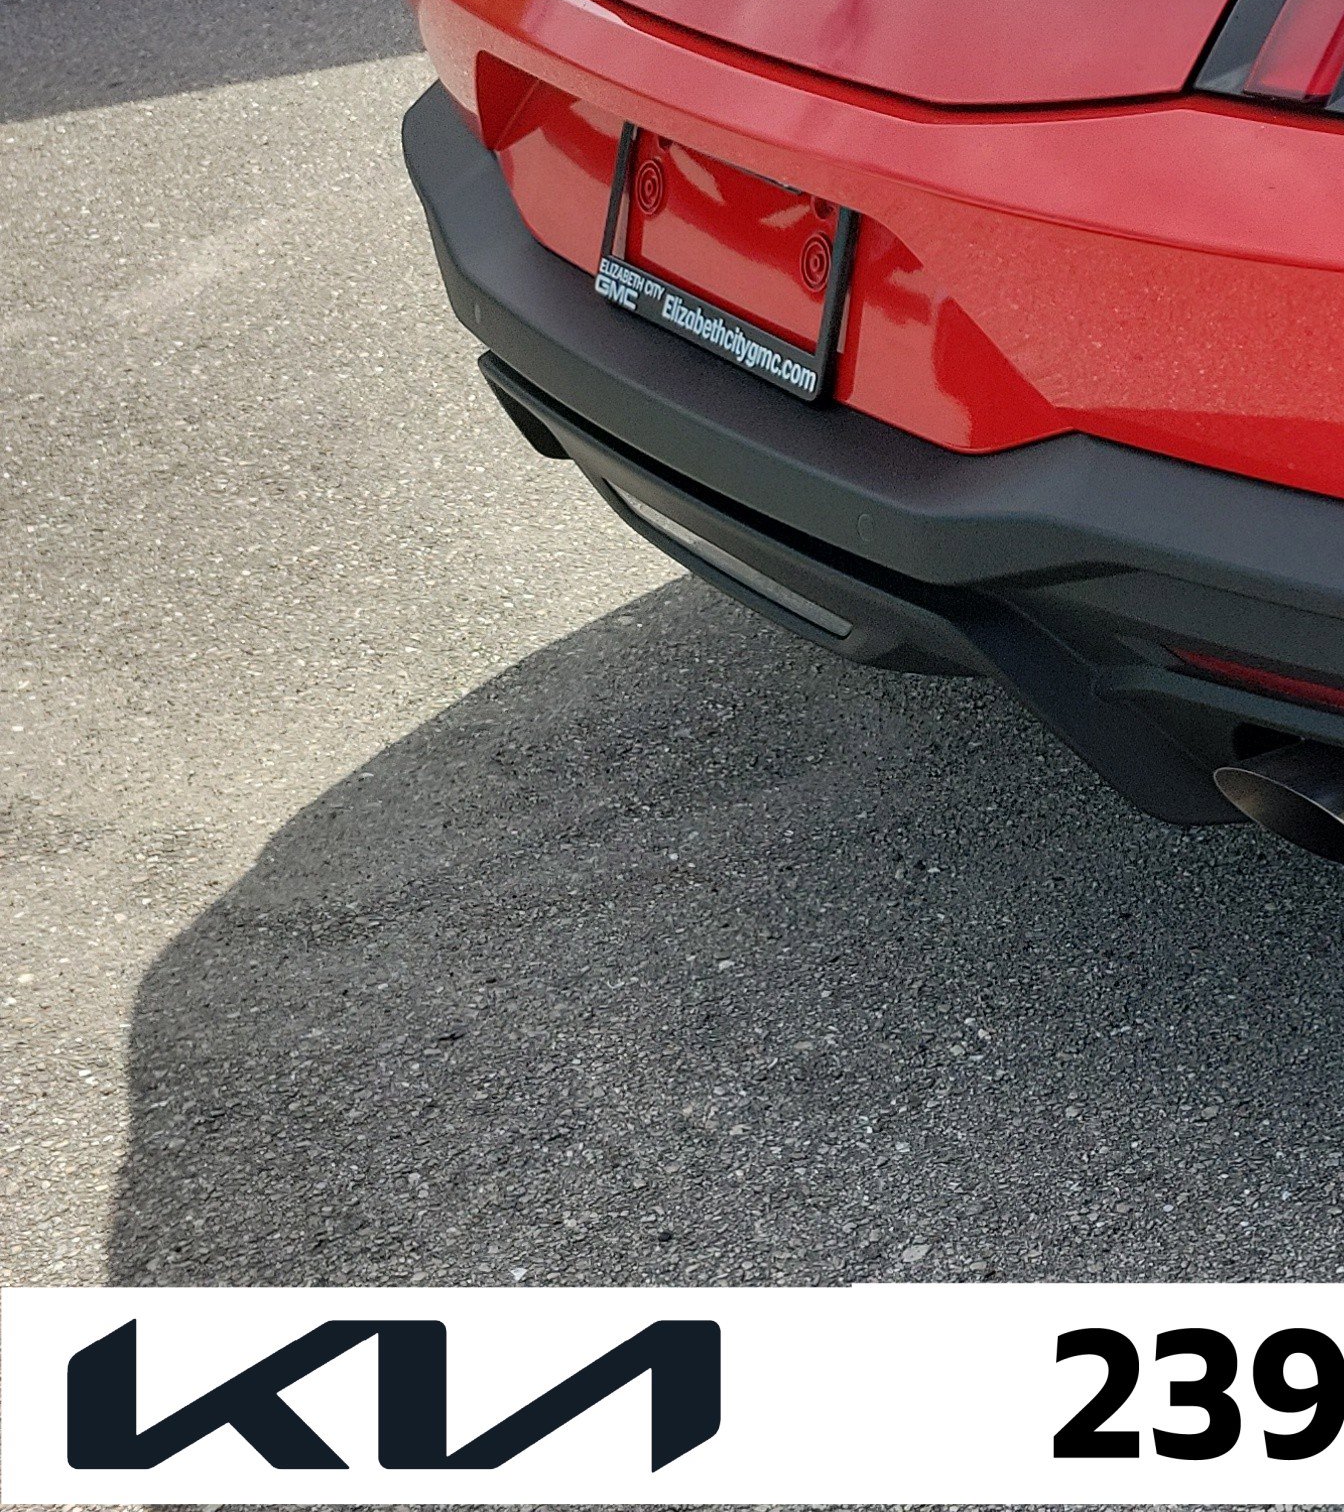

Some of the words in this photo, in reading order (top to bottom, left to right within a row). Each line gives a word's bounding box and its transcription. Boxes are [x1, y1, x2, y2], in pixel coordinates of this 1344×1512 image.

[595, 273, 639, 311] GMC
[600, 258, 645, 290] ELIZABETH
[643, 278, 665, 302] CITY
[662, 294, 817, 393] Elizabethcitygmc.com
